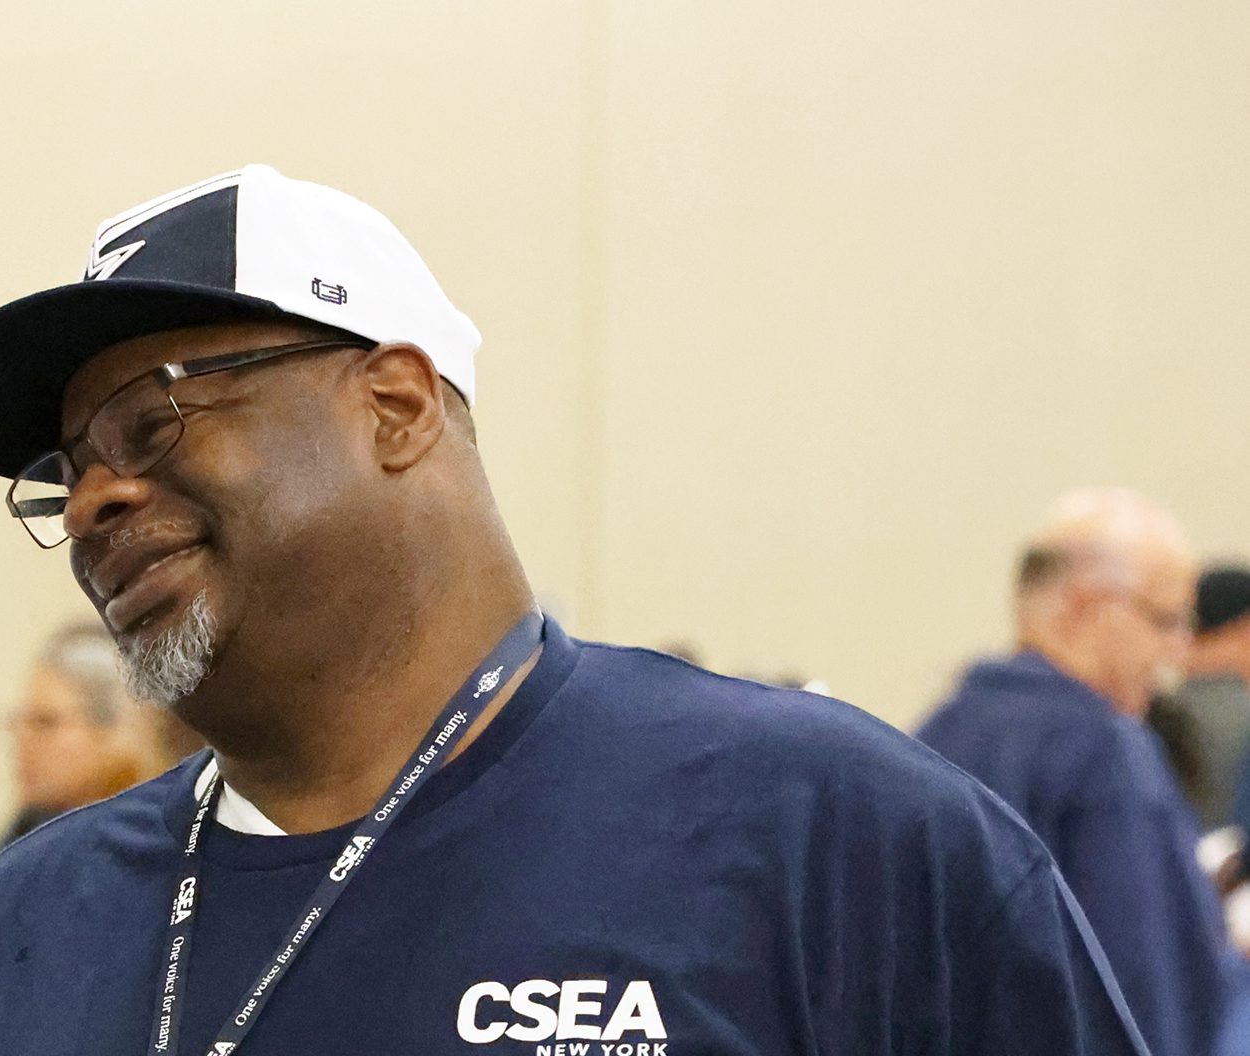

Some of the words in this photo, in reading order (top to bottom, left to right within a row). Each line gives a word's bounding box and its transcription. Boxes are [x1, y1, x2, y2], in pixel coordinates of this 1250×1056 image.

[374, 795, 399, 822] One
[395, 763, 425, 796] voice
[418, 745, 439, 765] for
[434, 709, 468, 747] many.
[184, 821, 202, 857] many.
[328, 835, 373, 882] CSEA
[174, 876, 197, 925] CSEA
[169, 935, 185, 962] One
[234, 998, 258, 1027] One
[252, 964, 281, 997] voice
[276, 944, 295, 964] for
[292, 906, 323, 945] many.
[164, 962, 180, 994] voice
[161, 994, 176, 1013] for
[456, 979, 668, 1044] CSEA
[154, 1014, 172, 1053] many.
